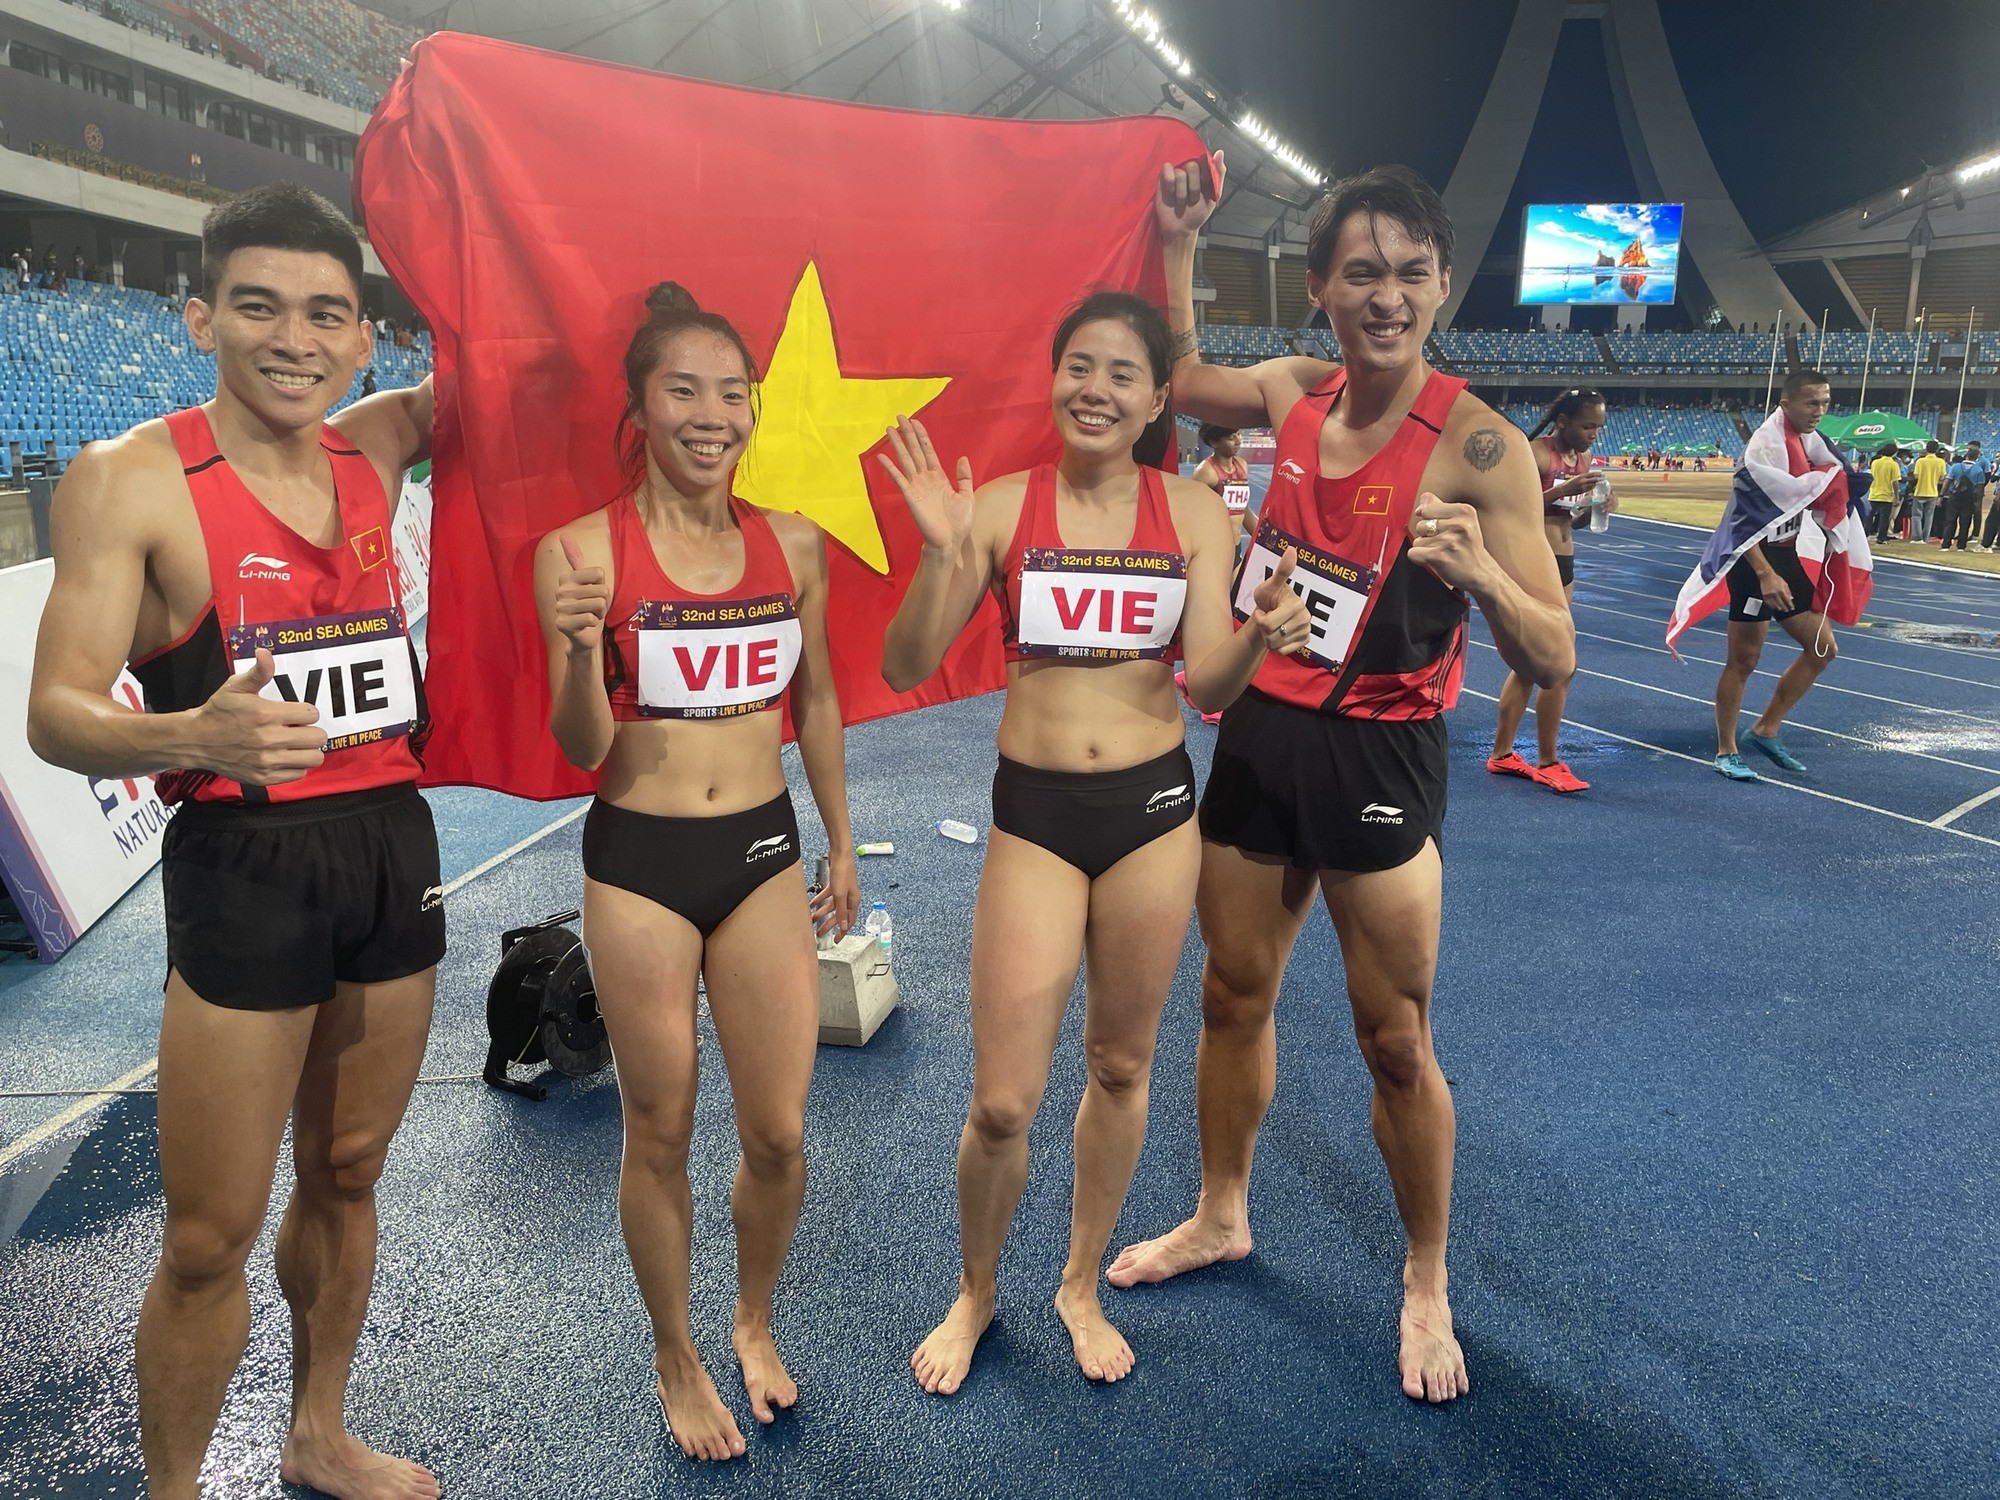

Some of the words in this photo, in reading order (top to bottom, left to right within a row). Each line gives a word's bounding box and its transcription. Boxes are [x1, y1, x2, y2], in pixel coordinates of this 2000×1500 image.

[1278, 468, 1301, 485] LI-NING
[1061, 555, 1092, 566] 32nd
[1095, 556, 1122, 568] SEA
[1124, 557, 1170, 571] GAMES
[1297, 548, 1316, 566] SEA
[1318, 558, 1358, 583] GAMES
[239, 570, 291, 581] LI-NING
[682, 609, 715, 622] 32nd
[719, 608, 745, 621] SEA
[748, 601, 785, 618] GAMES
[1051, 587, 1158, 634] VIE
[277, 627, 313, 645] 32nd
[316, 624, 343, 640] SEA
[345, 617, 389, 635] GAMES
[1092, 648, 1109, 658] LIVE
[1109, 649, 1118, 659] IN
[1119, 650, 1140, 659] PEACE
[672, 638, 778, 692] VIE
[273, 659, 389, 718] VIE
[720, 706, 737, 716] LIVE
[738, 704, 746, 714] IN
[747, 699, 767, 712] PEACE
[331, 737, 348, 750] LIVE
[349, 734, 358, 746] IN
[359, 729, 383, 744] PEACE
[1146, 792, 1191, 813] LI-NING
[1361, 814, 1404, 825] LI-NING
[746, 842, 791, 863] LI-NING
